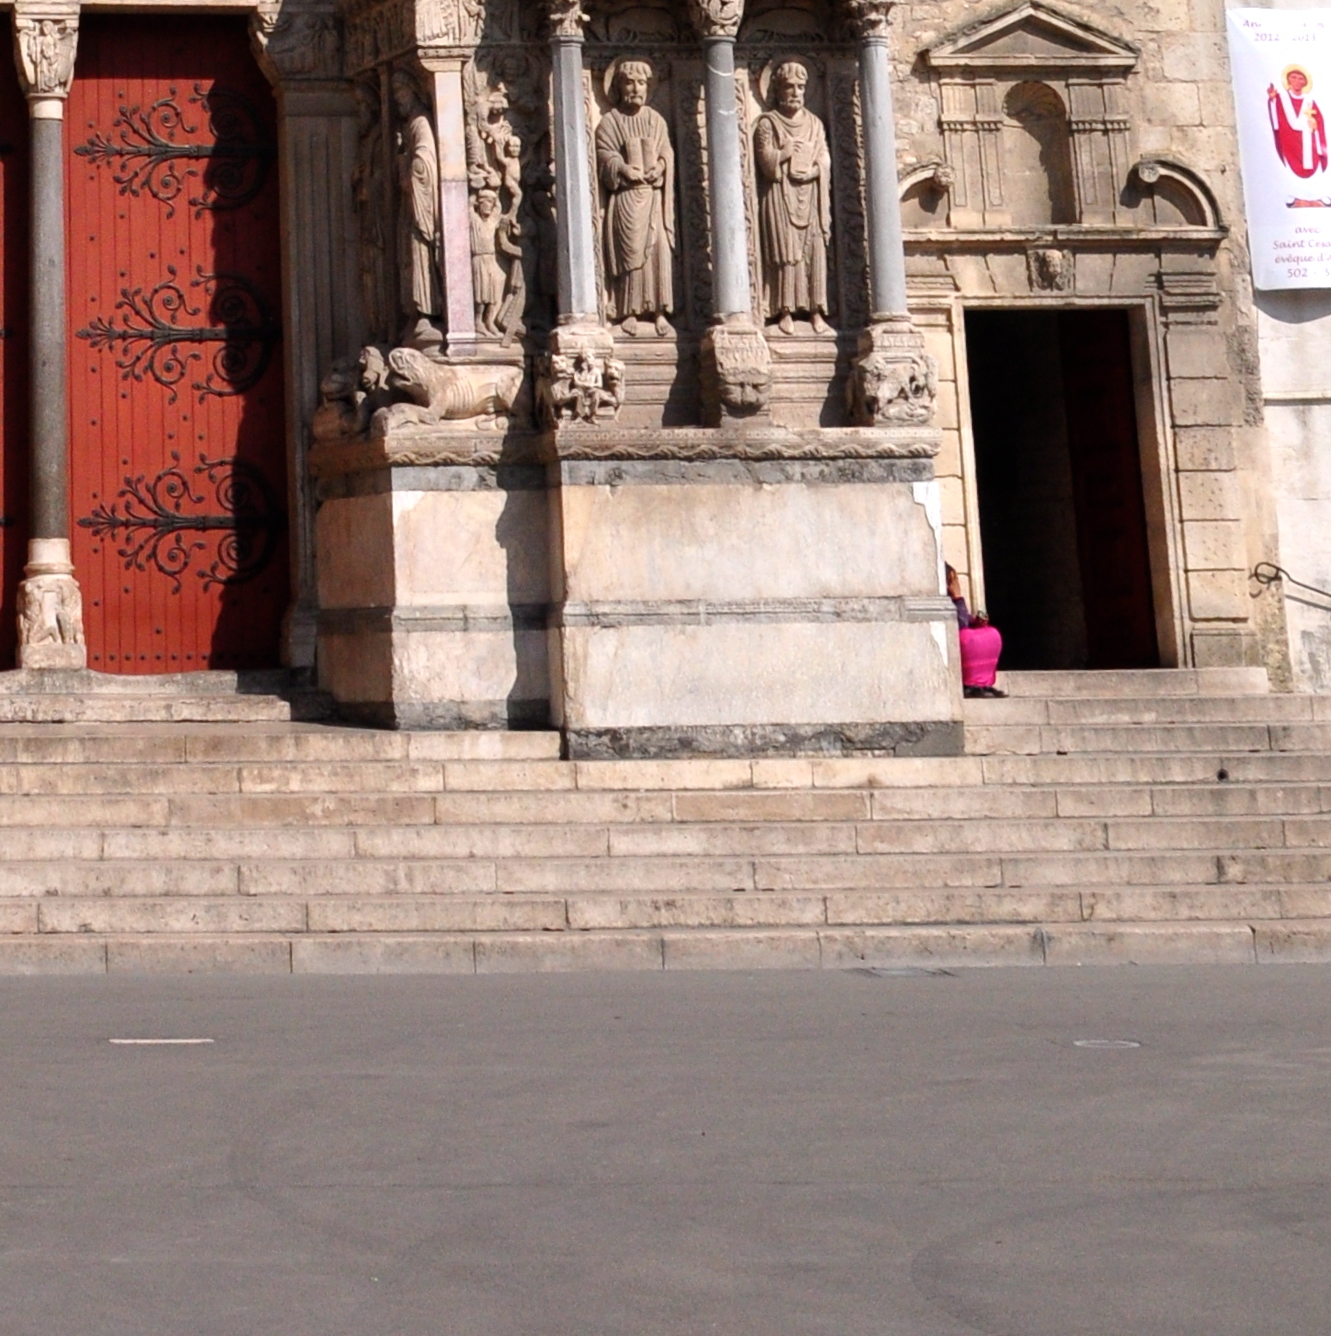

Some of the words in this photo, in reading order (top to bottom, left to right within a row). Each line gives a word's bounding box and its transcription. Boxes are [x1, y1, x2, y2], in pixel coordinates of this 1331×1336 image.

[1254, 32, 1280, 42] 2012
[1294, 226, 1321, 234] avec
[1272, 239, 1306, 250] Saint
[1287, 267, 1308, 279] 502
